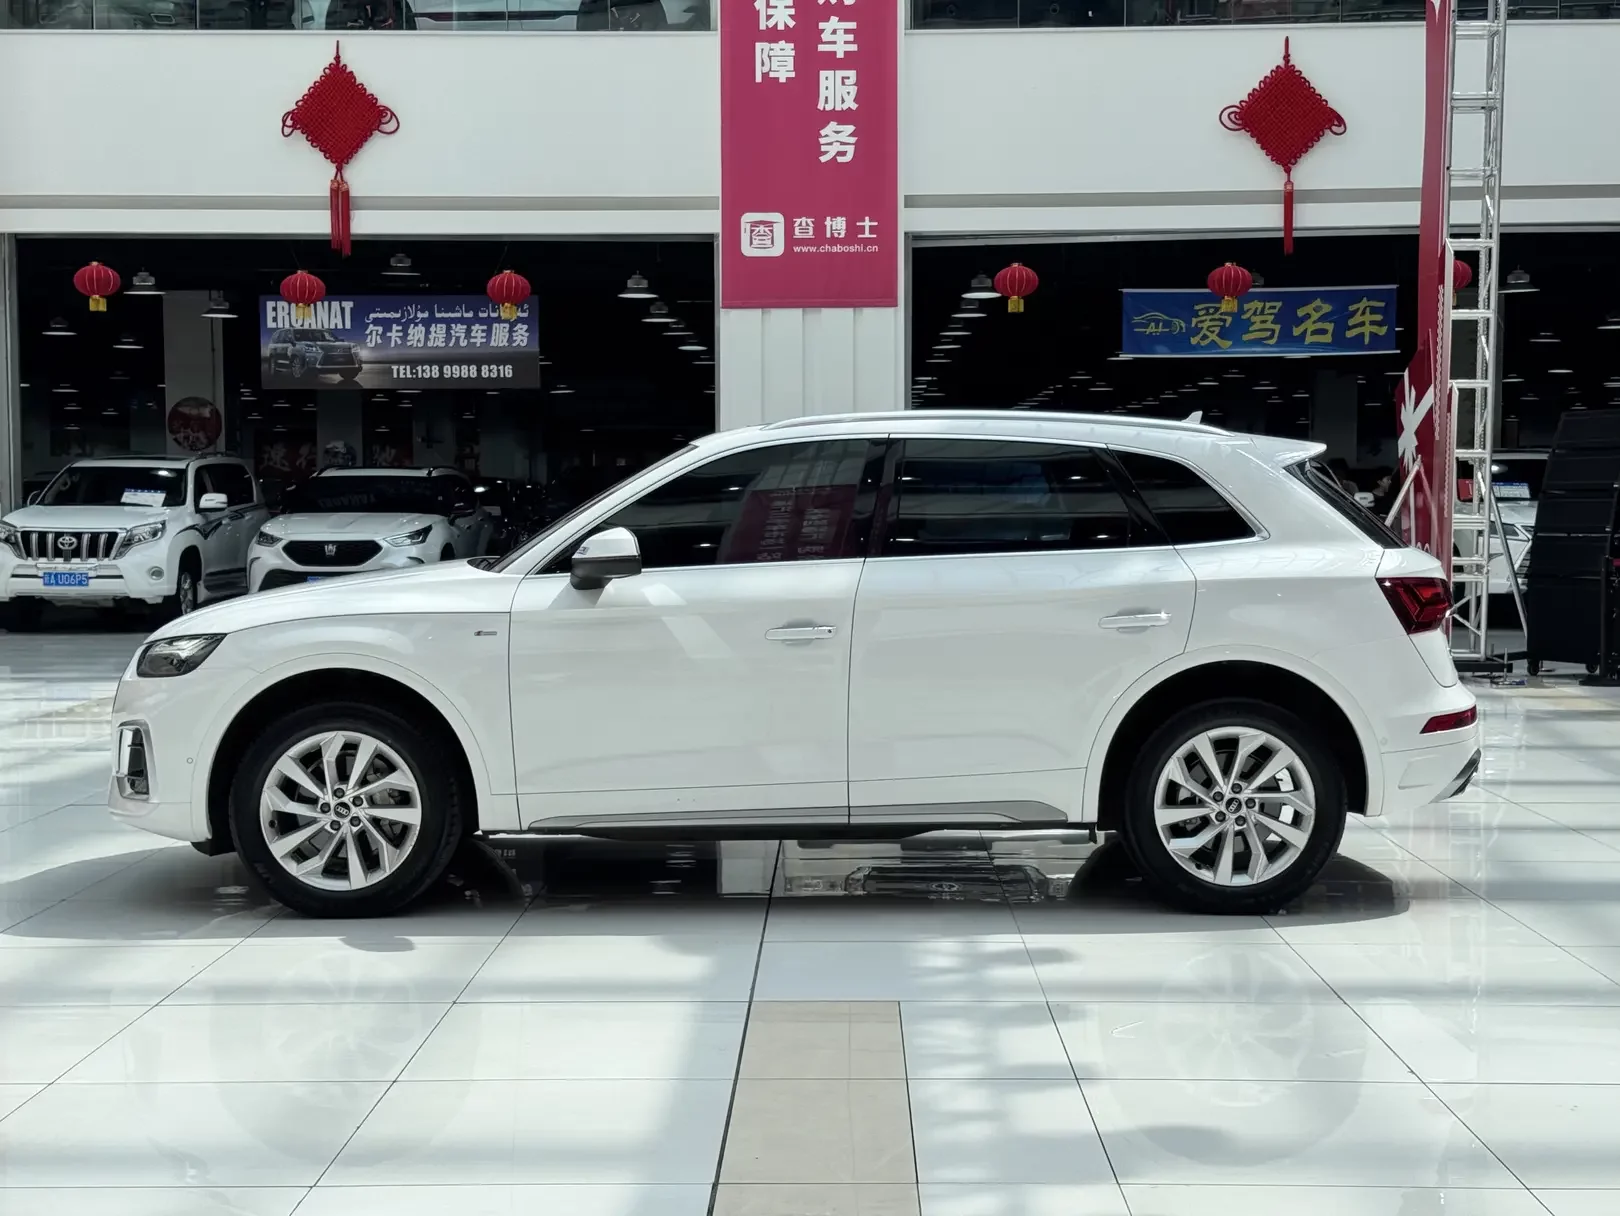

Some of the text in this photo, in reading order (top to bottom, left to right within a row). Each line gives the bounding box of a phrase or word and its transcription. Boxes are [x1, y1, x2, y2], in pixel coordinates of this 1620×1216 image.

[753, 0, 796, 83] 保障
[817, 0, 859, 163] 车服务
[793, 216, 878, 238] 查博士
[793, 244, 879, 253] www.chaboshi.cn
[365, 323, 530, 348] 尔卡纳提汽车服务
[1190, 297, 1389, 349] 爱驾名车
[391, 364, 513, 379] TEL:138 9988 8316
